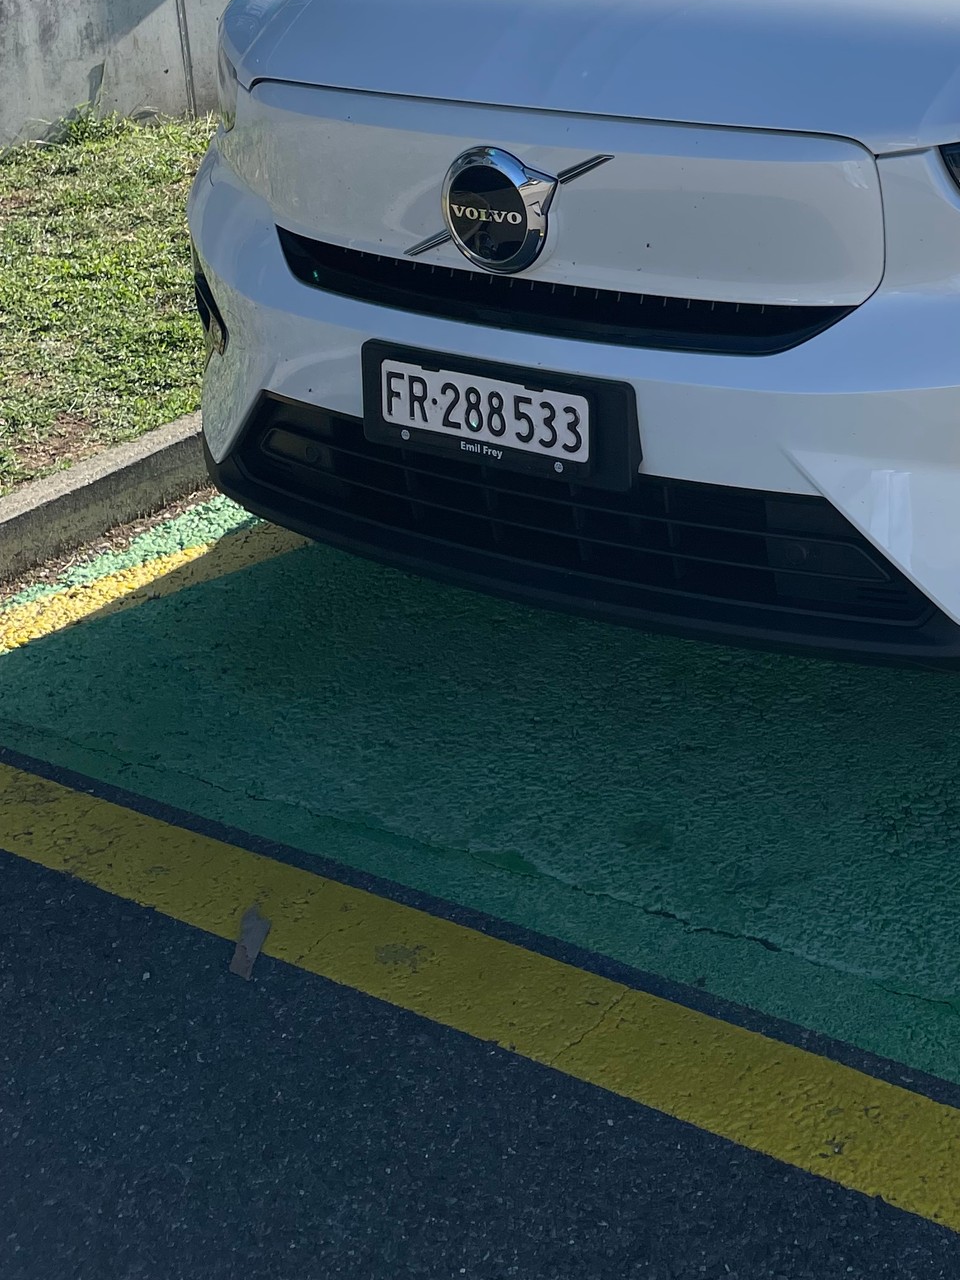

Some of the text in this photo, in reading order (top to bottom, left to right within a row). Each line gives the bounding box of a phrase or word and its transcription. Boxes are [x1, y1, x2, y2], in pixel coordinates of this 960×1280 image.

[450, 204, 523, 225] VOLVO
[460, 441, 503, 460] Emil Frey
